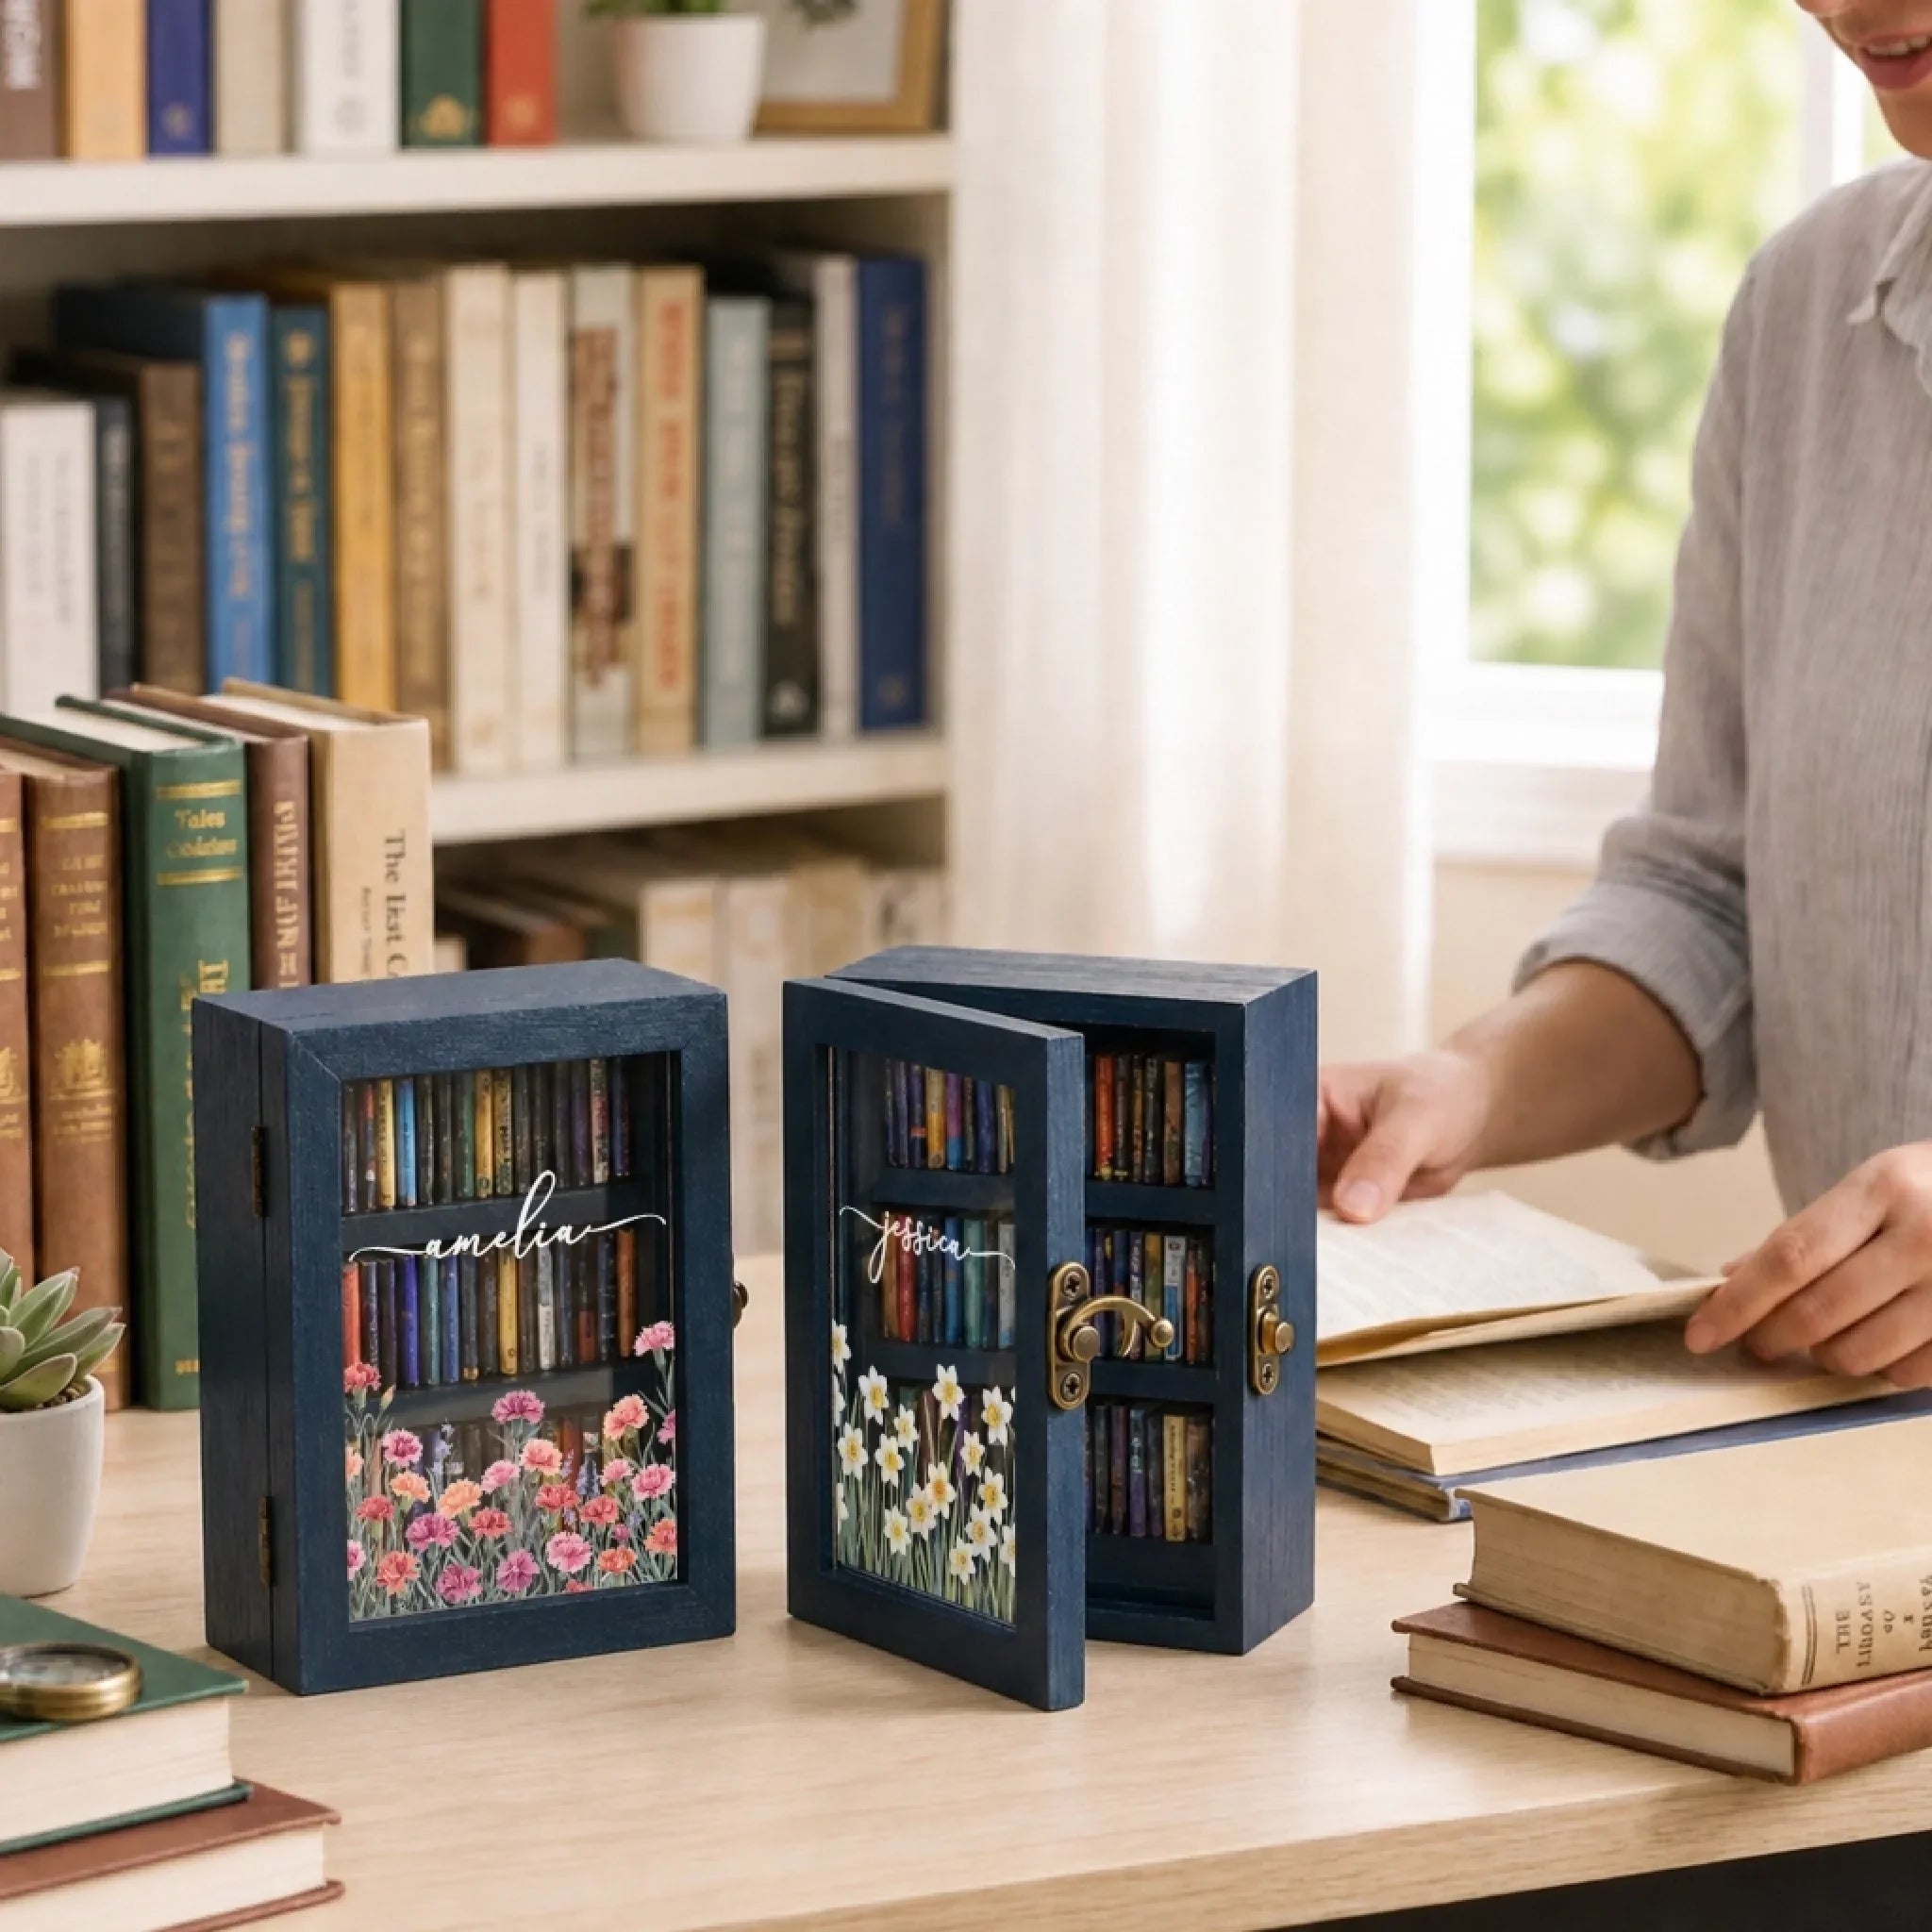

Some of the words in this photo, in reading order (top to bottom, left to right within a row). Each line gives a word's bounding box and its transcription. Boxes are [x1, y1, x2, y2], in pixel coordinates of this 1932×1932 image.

[385, 827, 407, 883] The
[348, 1170, 667, 1259] amelia
[840, 1206, 1016, 1284] jessica
[1835, 1609, 1851, 1654] THE
